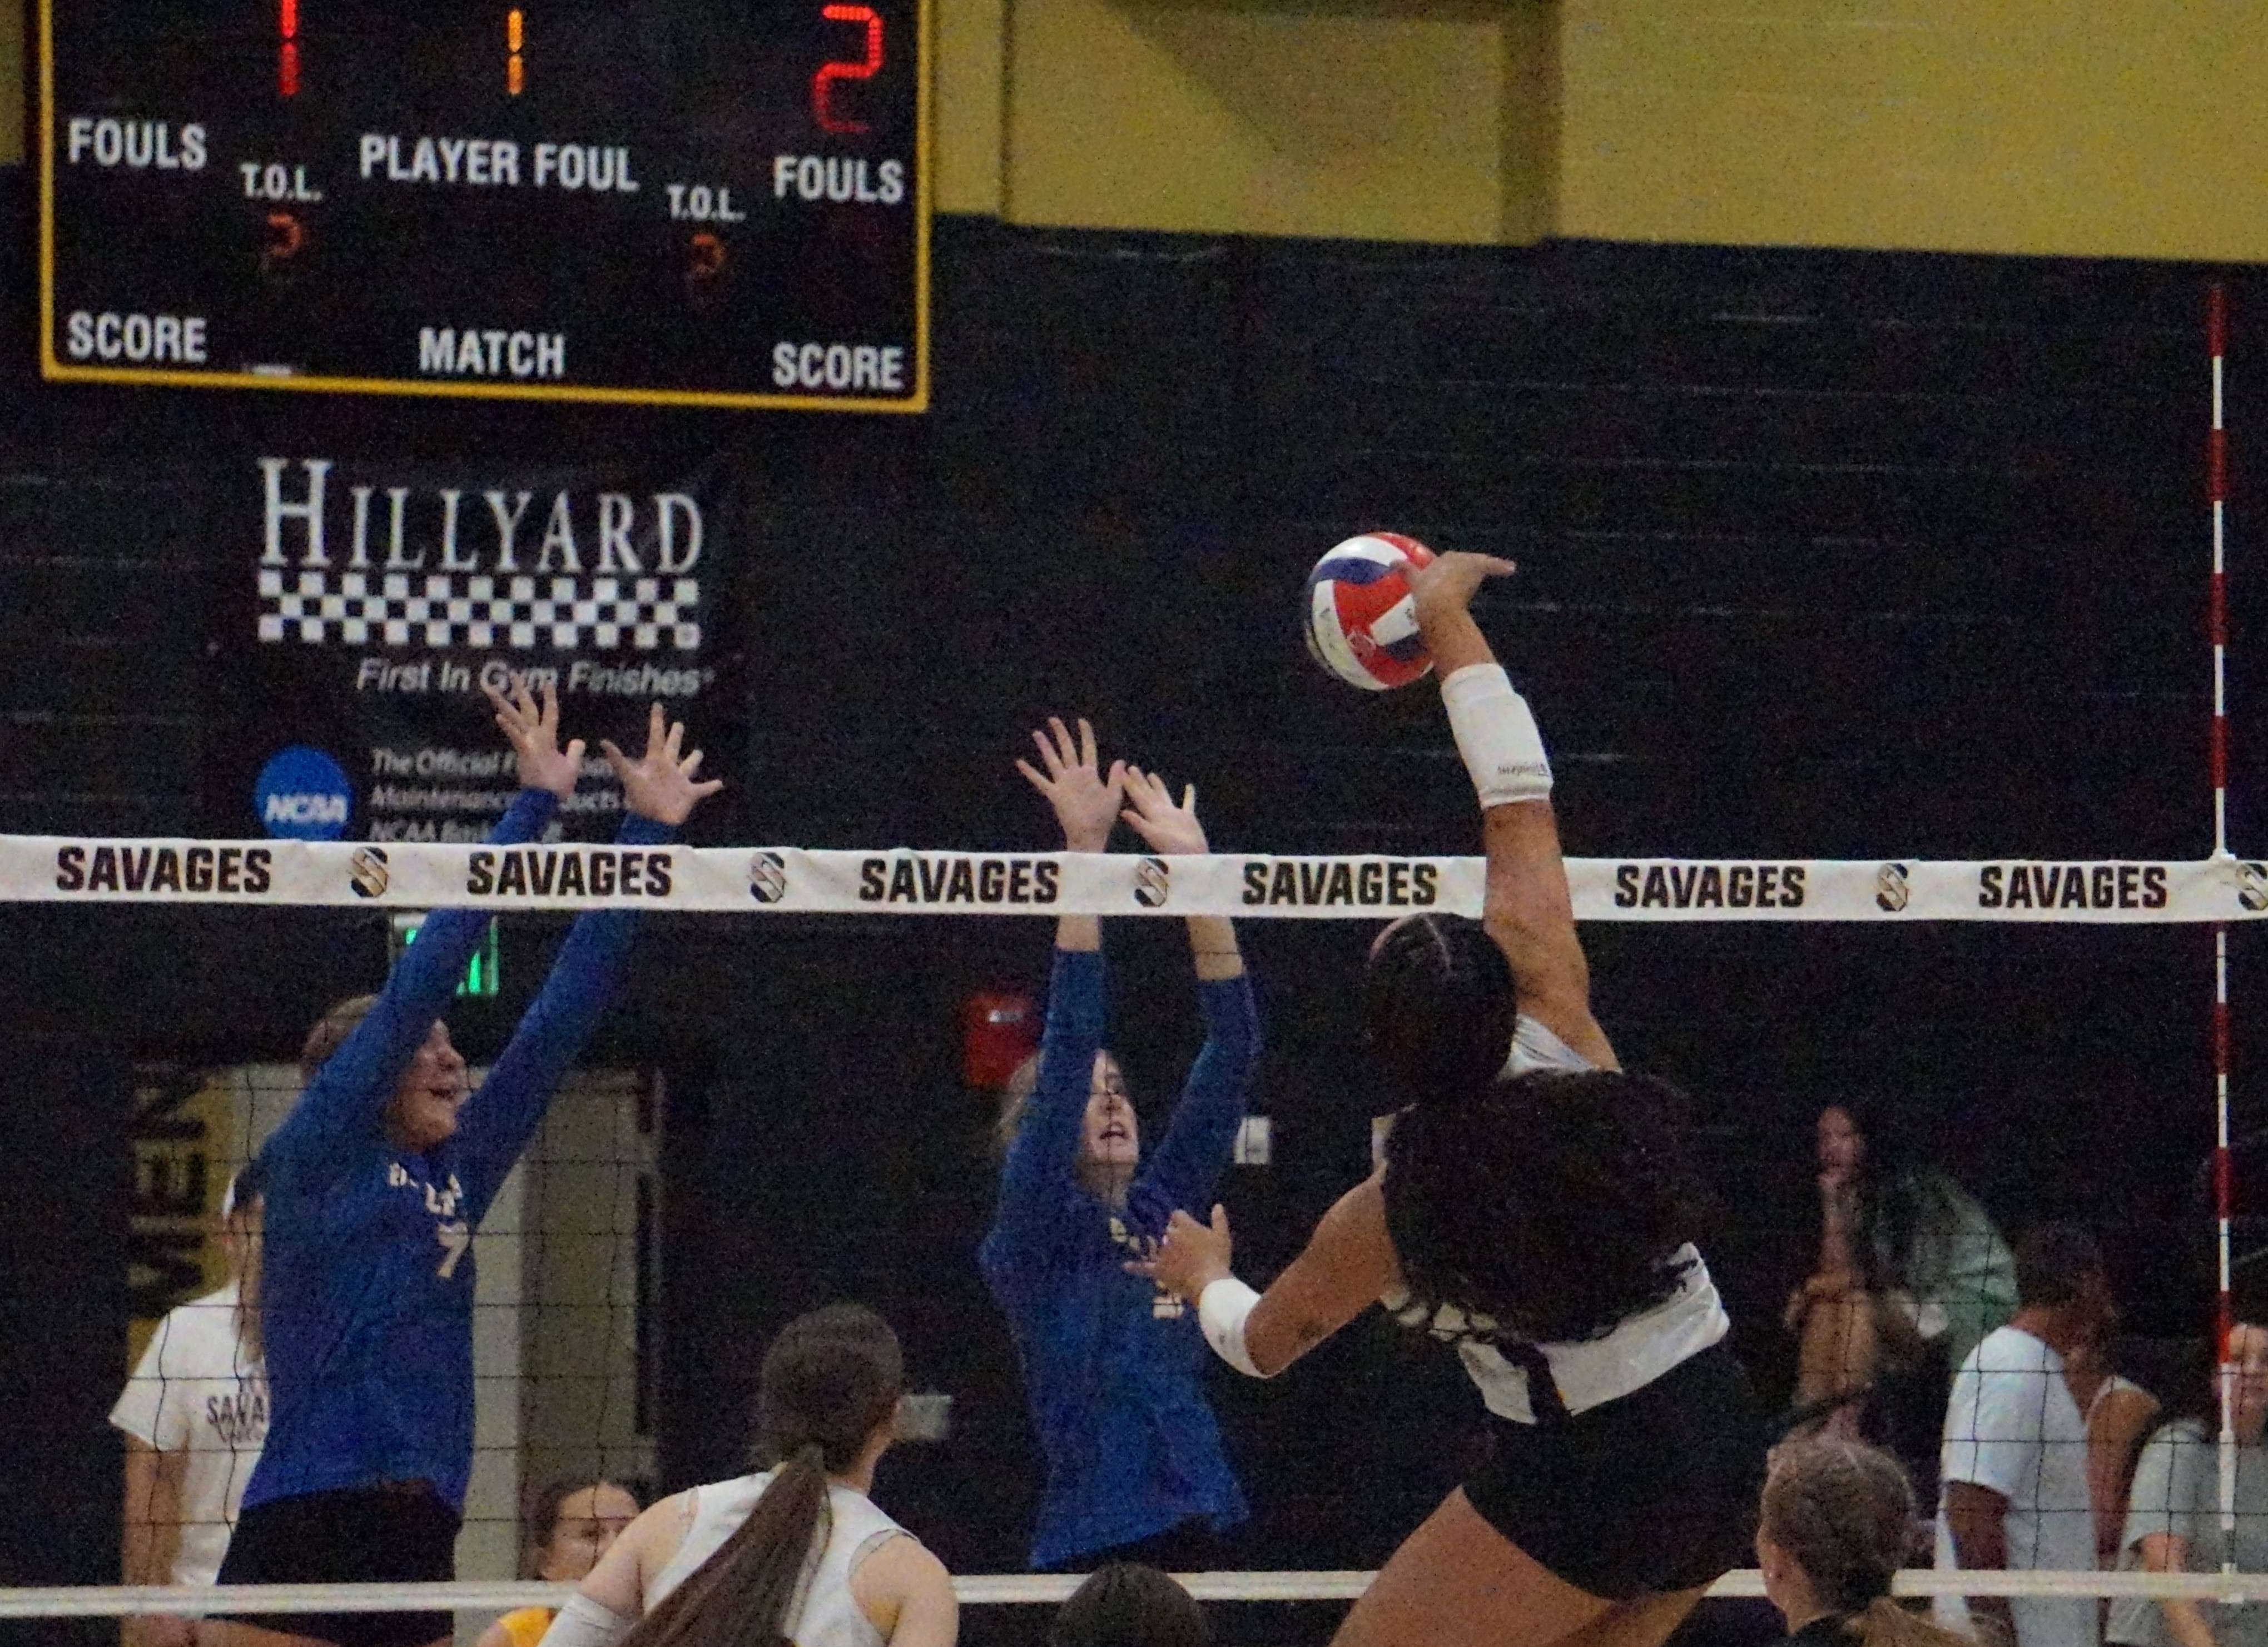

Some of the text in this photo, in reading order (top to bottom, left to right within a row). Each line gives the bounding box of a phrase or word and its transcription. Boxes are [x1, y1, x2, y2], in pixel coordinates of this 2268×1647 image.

[507, 8, 524, 95] 1
[810, 3, 886, 134] 2
[67, 117, 207, 170] FOULS
[359, 133, 640, 192] PLAYER FOUL
[240, 163, 324, 203] T.O.L.
[667, 183, 746, 222] T.O.L.
[773, 155, 905, 205] FOULS
[67, 310, 207, 362] SCORE
[419, 326, 566, 377] MATCH
[772, 341, 905, 391] SCORE
[257, 456, 704, 576] HILLYARD
[356, 658, 431, 694] First
[438, 661, 471, 693] In
[265, 792, 348, 823] NCAA
[56, 845, 272, 894] SAVAGES
[466, 850, 673, 898] SAVAGES
[859, 858, 1059, 905] SAVAGES
[1242, 860, 1438, 907] SAVAGES
[1614, 864, 1805, 909] SAVAGES
[1978, 865, 2168, 909] SAVAGES
[436, 1221, 469, 1278] 7
[206, 1394, 265, 1425] SAVA
